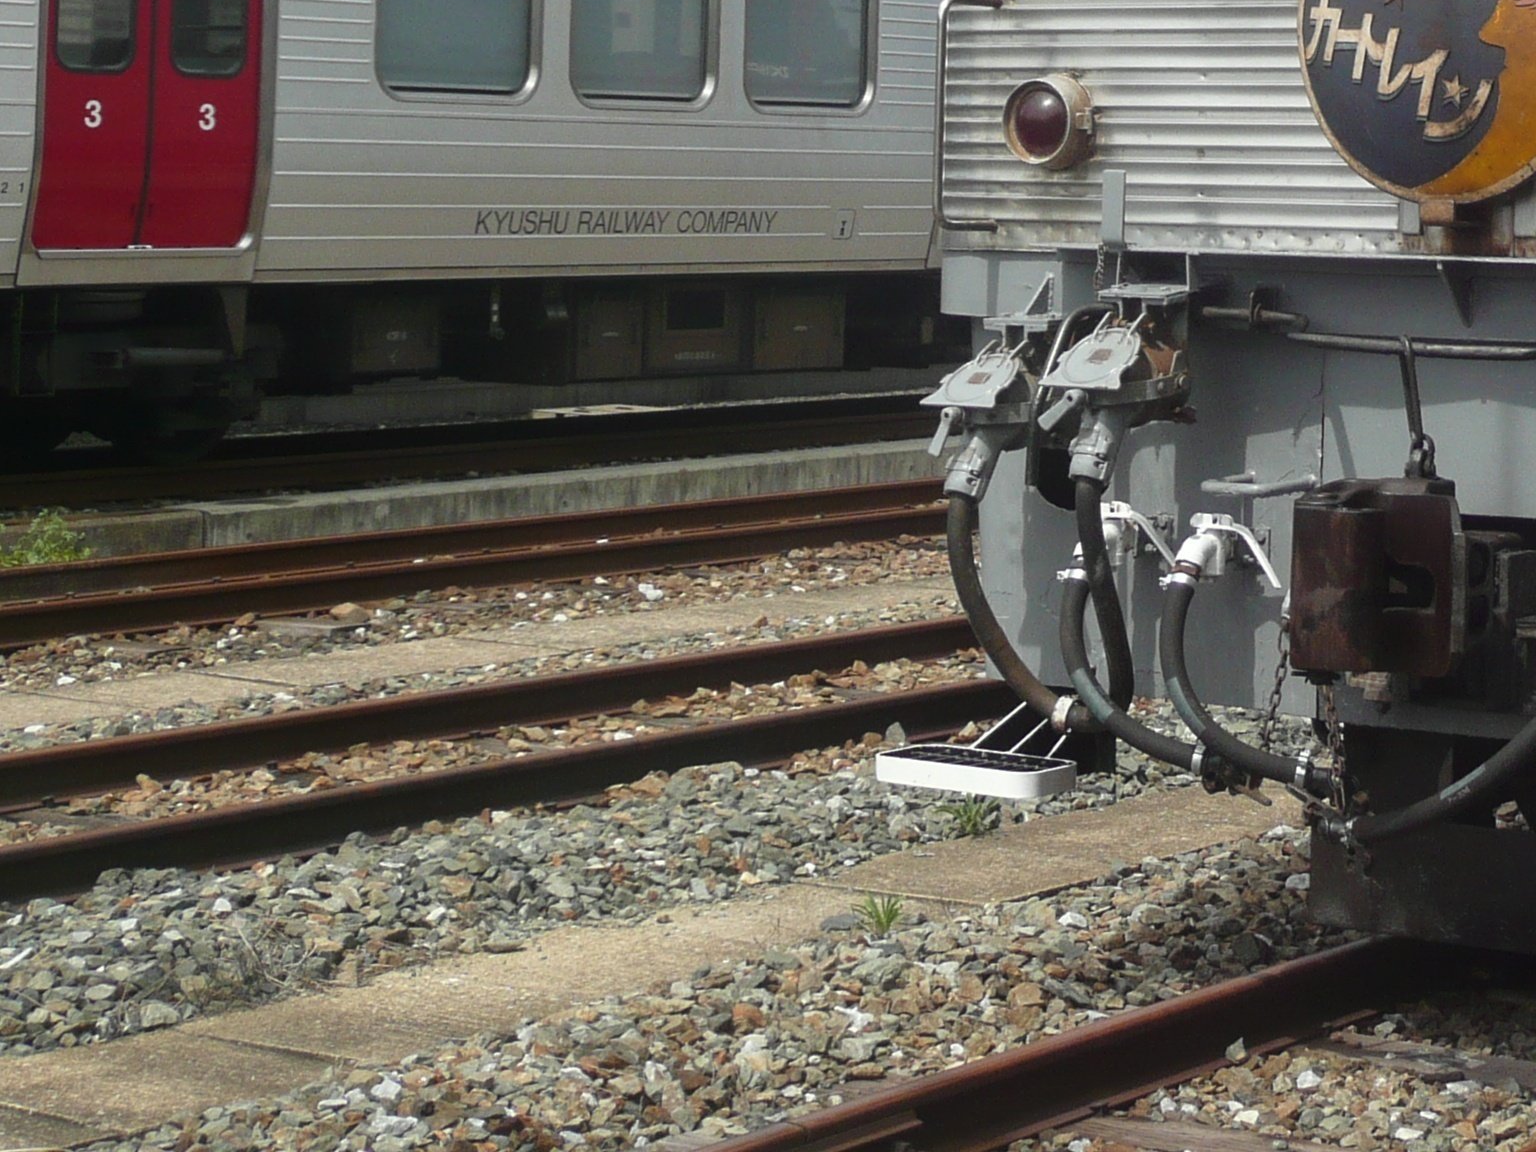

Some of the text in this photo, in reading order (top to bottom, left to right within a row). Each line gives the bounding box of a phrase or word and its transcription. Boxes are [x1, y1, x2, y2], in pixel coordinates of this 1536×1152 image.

[83, 100, 103, 128] 3
[198, 103, 217, 132] 3
[474, 210, 778, 235] KYUSHU RAILWAY COMPANY
